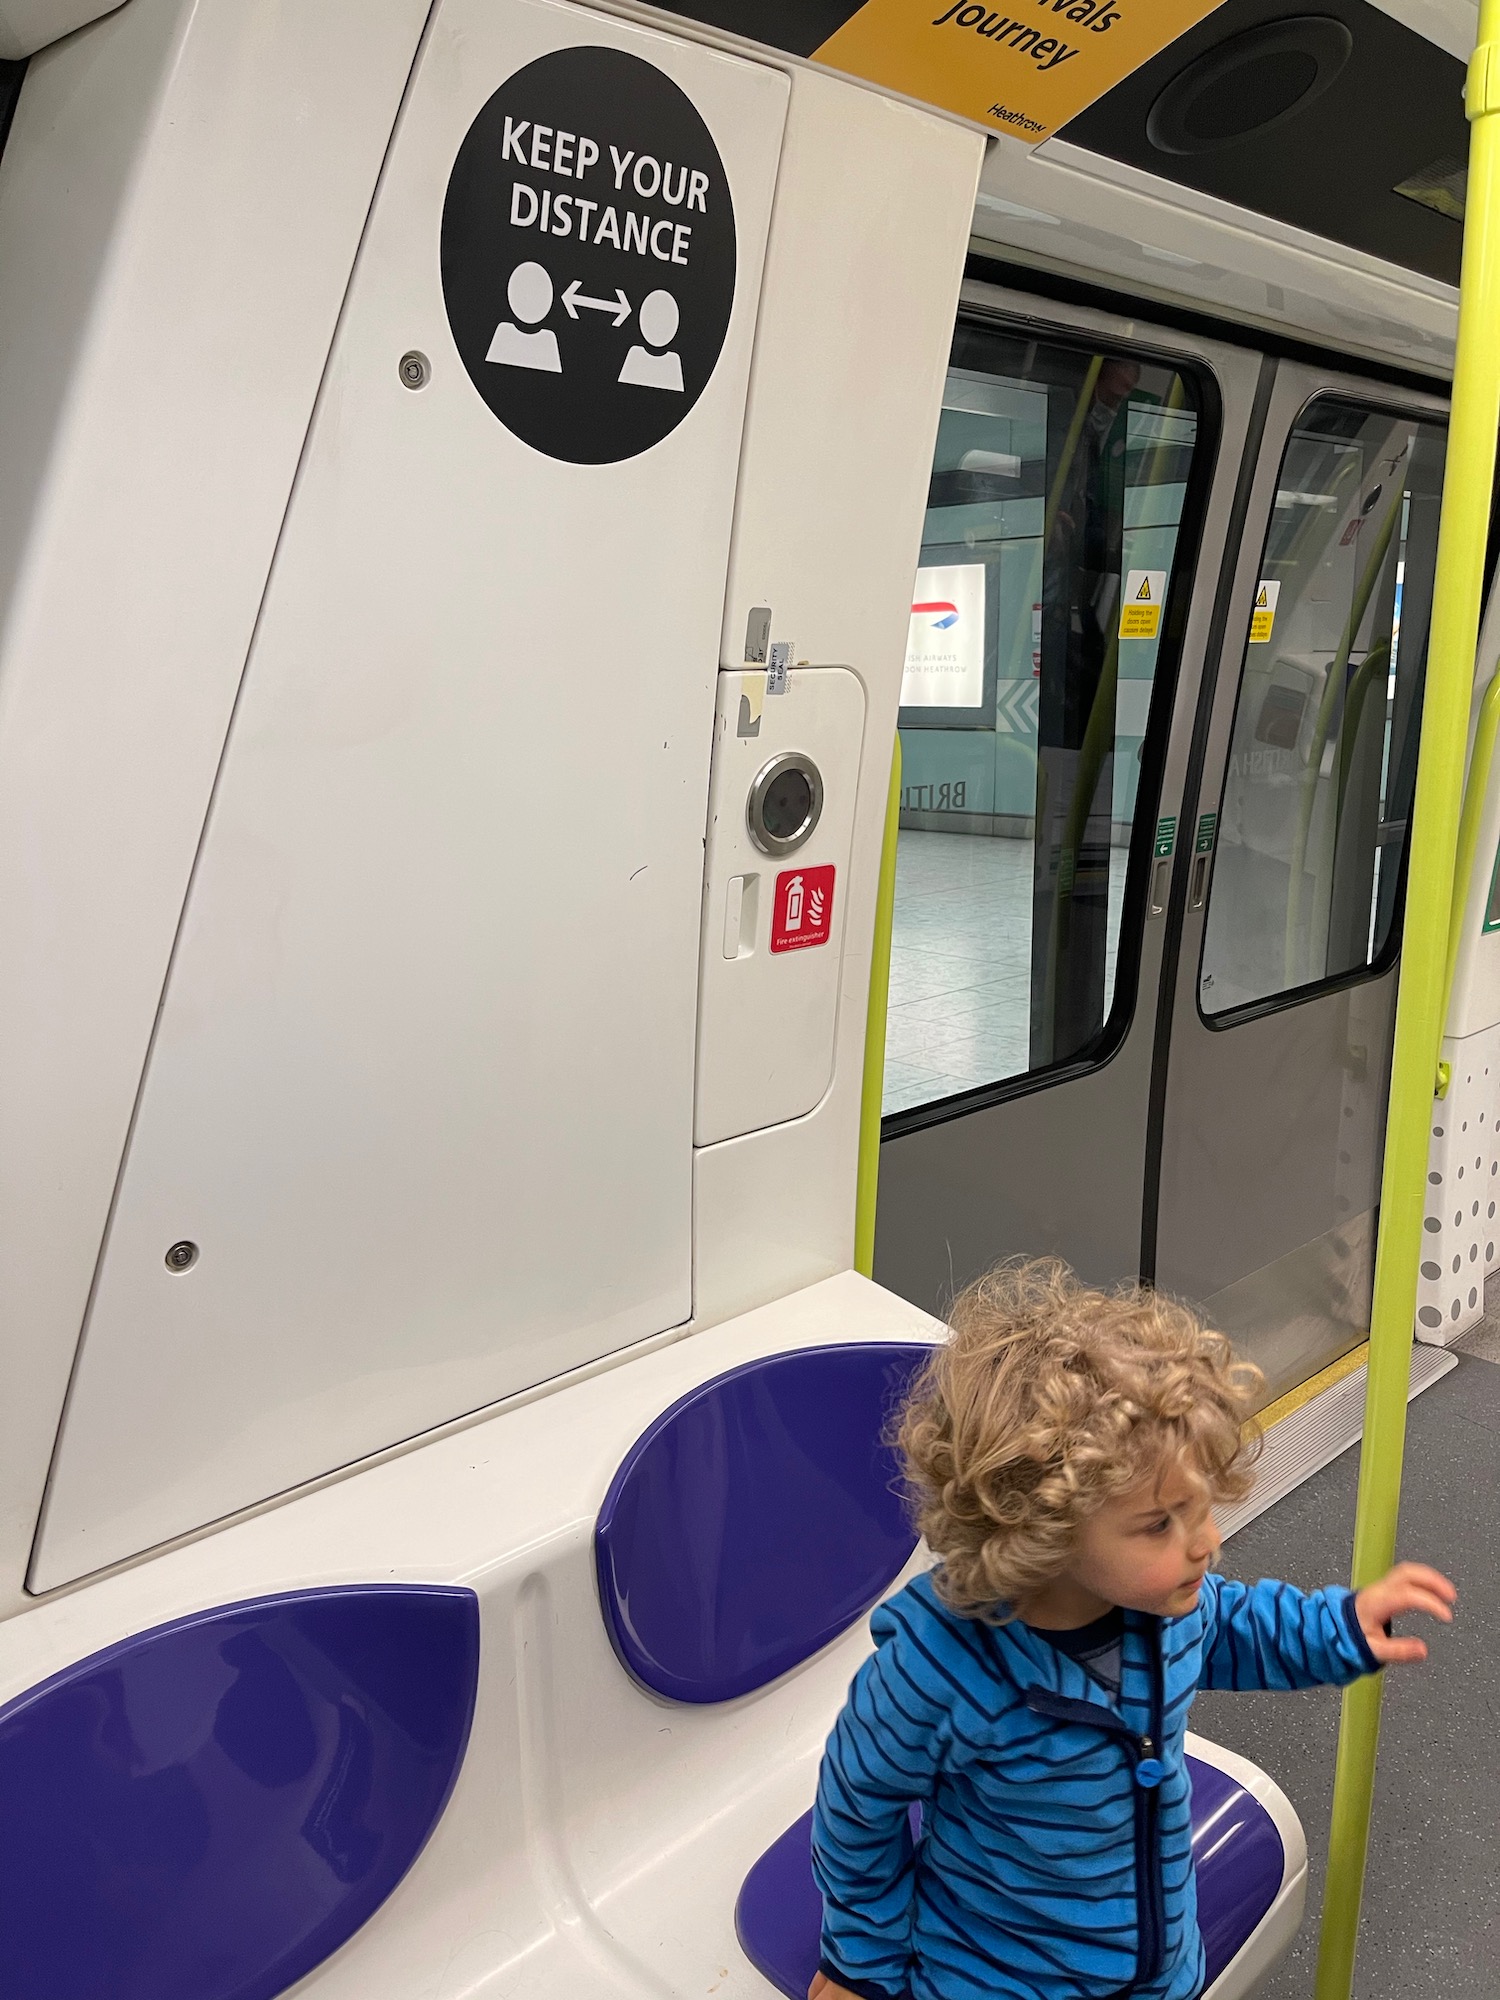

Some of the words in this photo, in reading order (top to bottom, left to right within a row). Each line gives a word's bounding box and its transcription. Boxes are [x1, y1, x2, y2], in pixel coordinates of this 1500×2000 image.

[1038, 0, 1122, 33] vals
[931, 0, 1080, 70] journey
[986, 103, 1047, 133] Heathrow
[501, 115, 600, 180] KEEP
[608, 144, 710, 214] YOUR
[509, 182, 693, 266] DISTANCE
[769, 647, 778, 691] SECURITY
[777, 658, 785, 681] SEAL
[923, 654, 957, 662] AIRWAYS
[924, 665, 967, 673] HEATHROW
[776, 937, 788, 945] Fire
[788, 931, 824, 943] extinguisher
